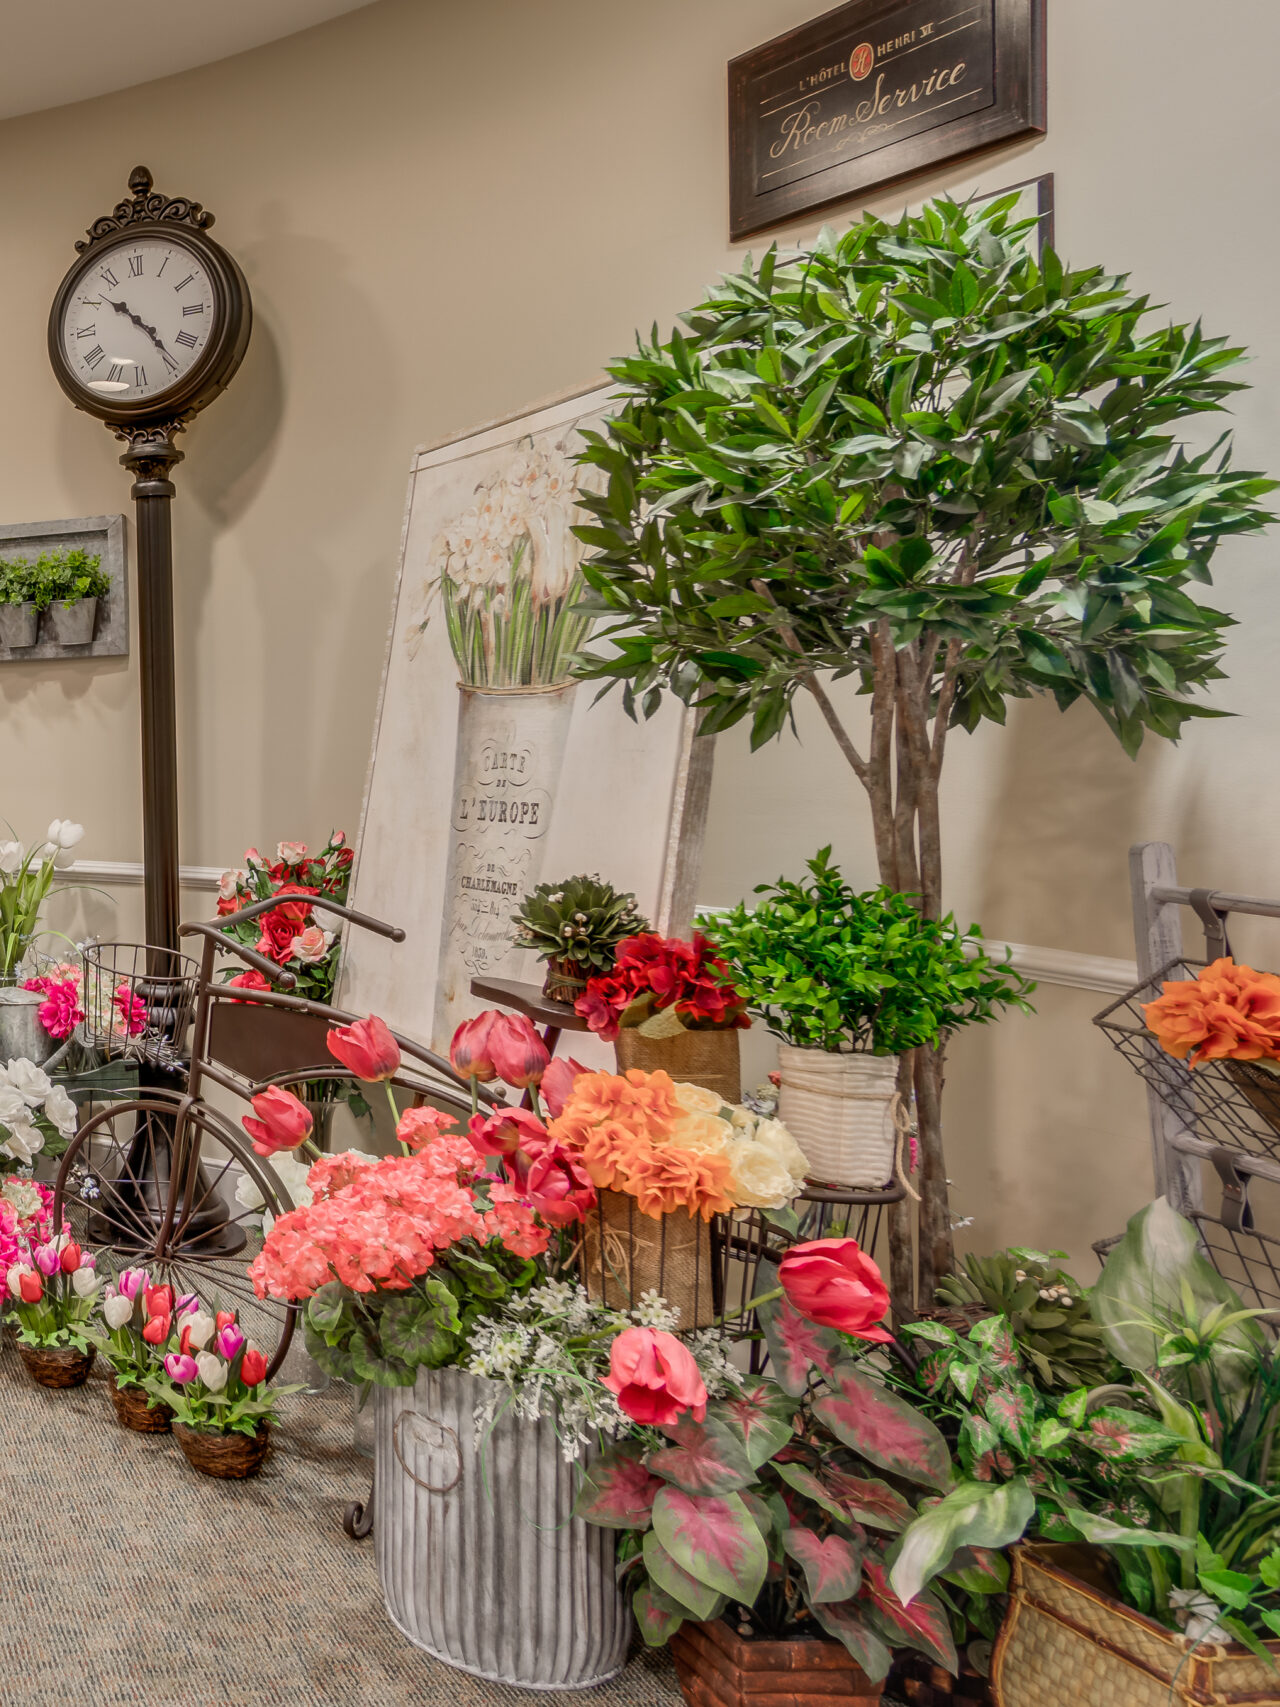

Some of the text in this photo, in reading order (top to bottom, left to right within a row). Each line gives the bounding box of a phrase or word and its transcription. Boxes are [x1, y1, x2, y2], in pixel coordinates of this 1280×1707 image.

[799, 62, 848, 91] L'HÔTEL
[877, 31, 916, 56] HENRI
[770, 62, 968, 158] Room Service
[127, 255, 145, 279] XII
[100, 268, 120, 291] XI
[483, 752, 527, 774] CARTE
[496, 779, 507, 788] DE
[459, 798, 540, 825] L'EUROPE
[486, 863, 496, 873] DE
[461, 875, 518, 896] CHARLEMAGNE
